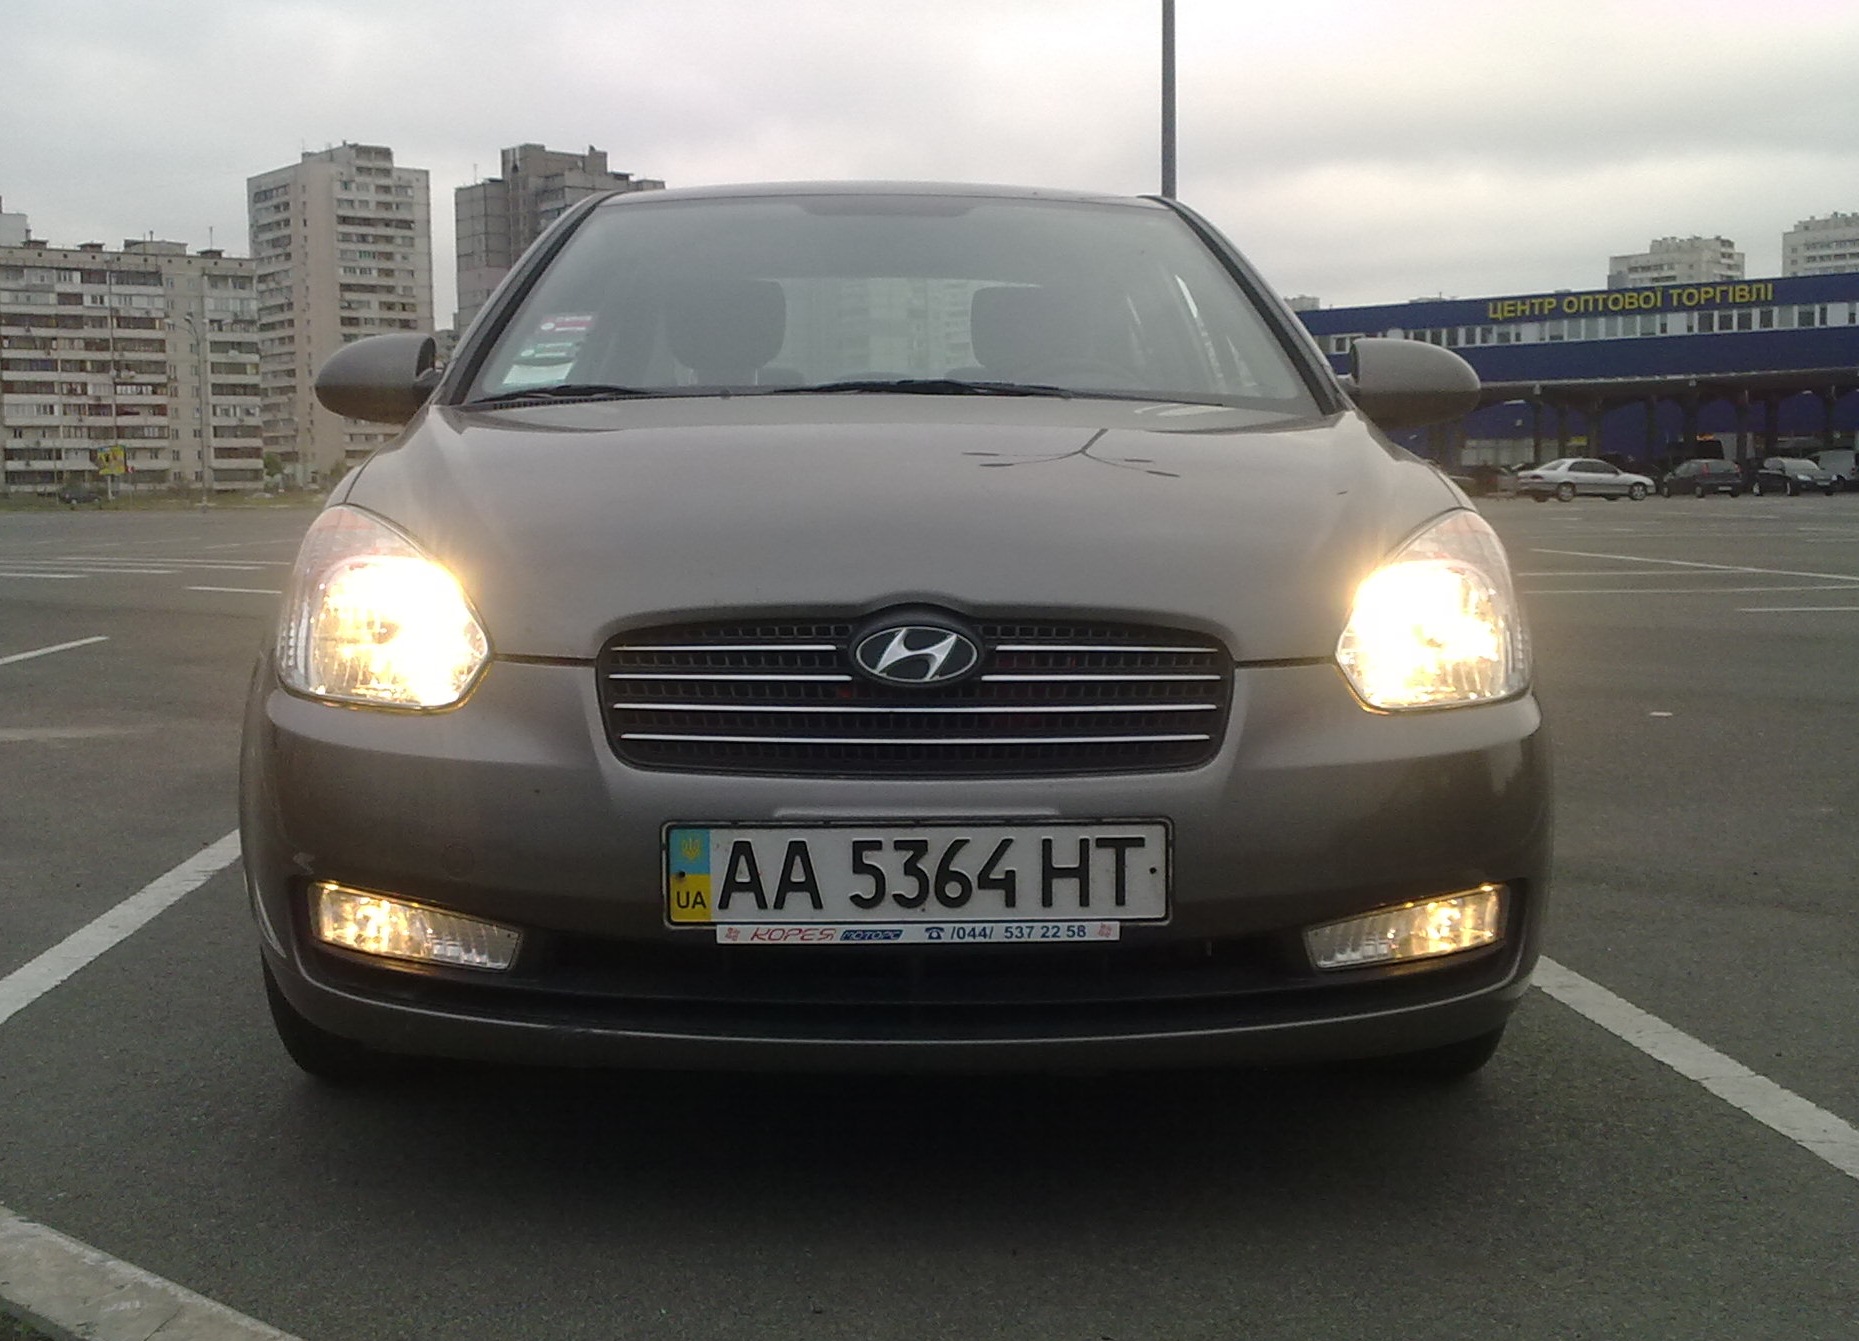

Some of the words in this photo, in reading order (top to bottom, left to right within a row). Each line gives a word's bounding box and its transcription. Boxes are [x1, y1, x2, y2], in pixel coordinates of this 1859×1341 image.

[1488, 297, 1557, 320] ЦЕНТР
[1562, 286, 1663, 314] ОПТОВОЇ
[1669, 283, 1773, 306] ТОРГІВЛІ
[717, 840, 824, 910] AA
[848, 838, 1017, 909] 5364
[1040, 837, 1146, 908] HT
[676, 890, 707, 909] UA
[950, 926, 994, 940] /044/
[1004, 925, 1034, 940] 537
[1040, 925, 1061, 939] 22
[1066, 924, 1087, 938] 58
